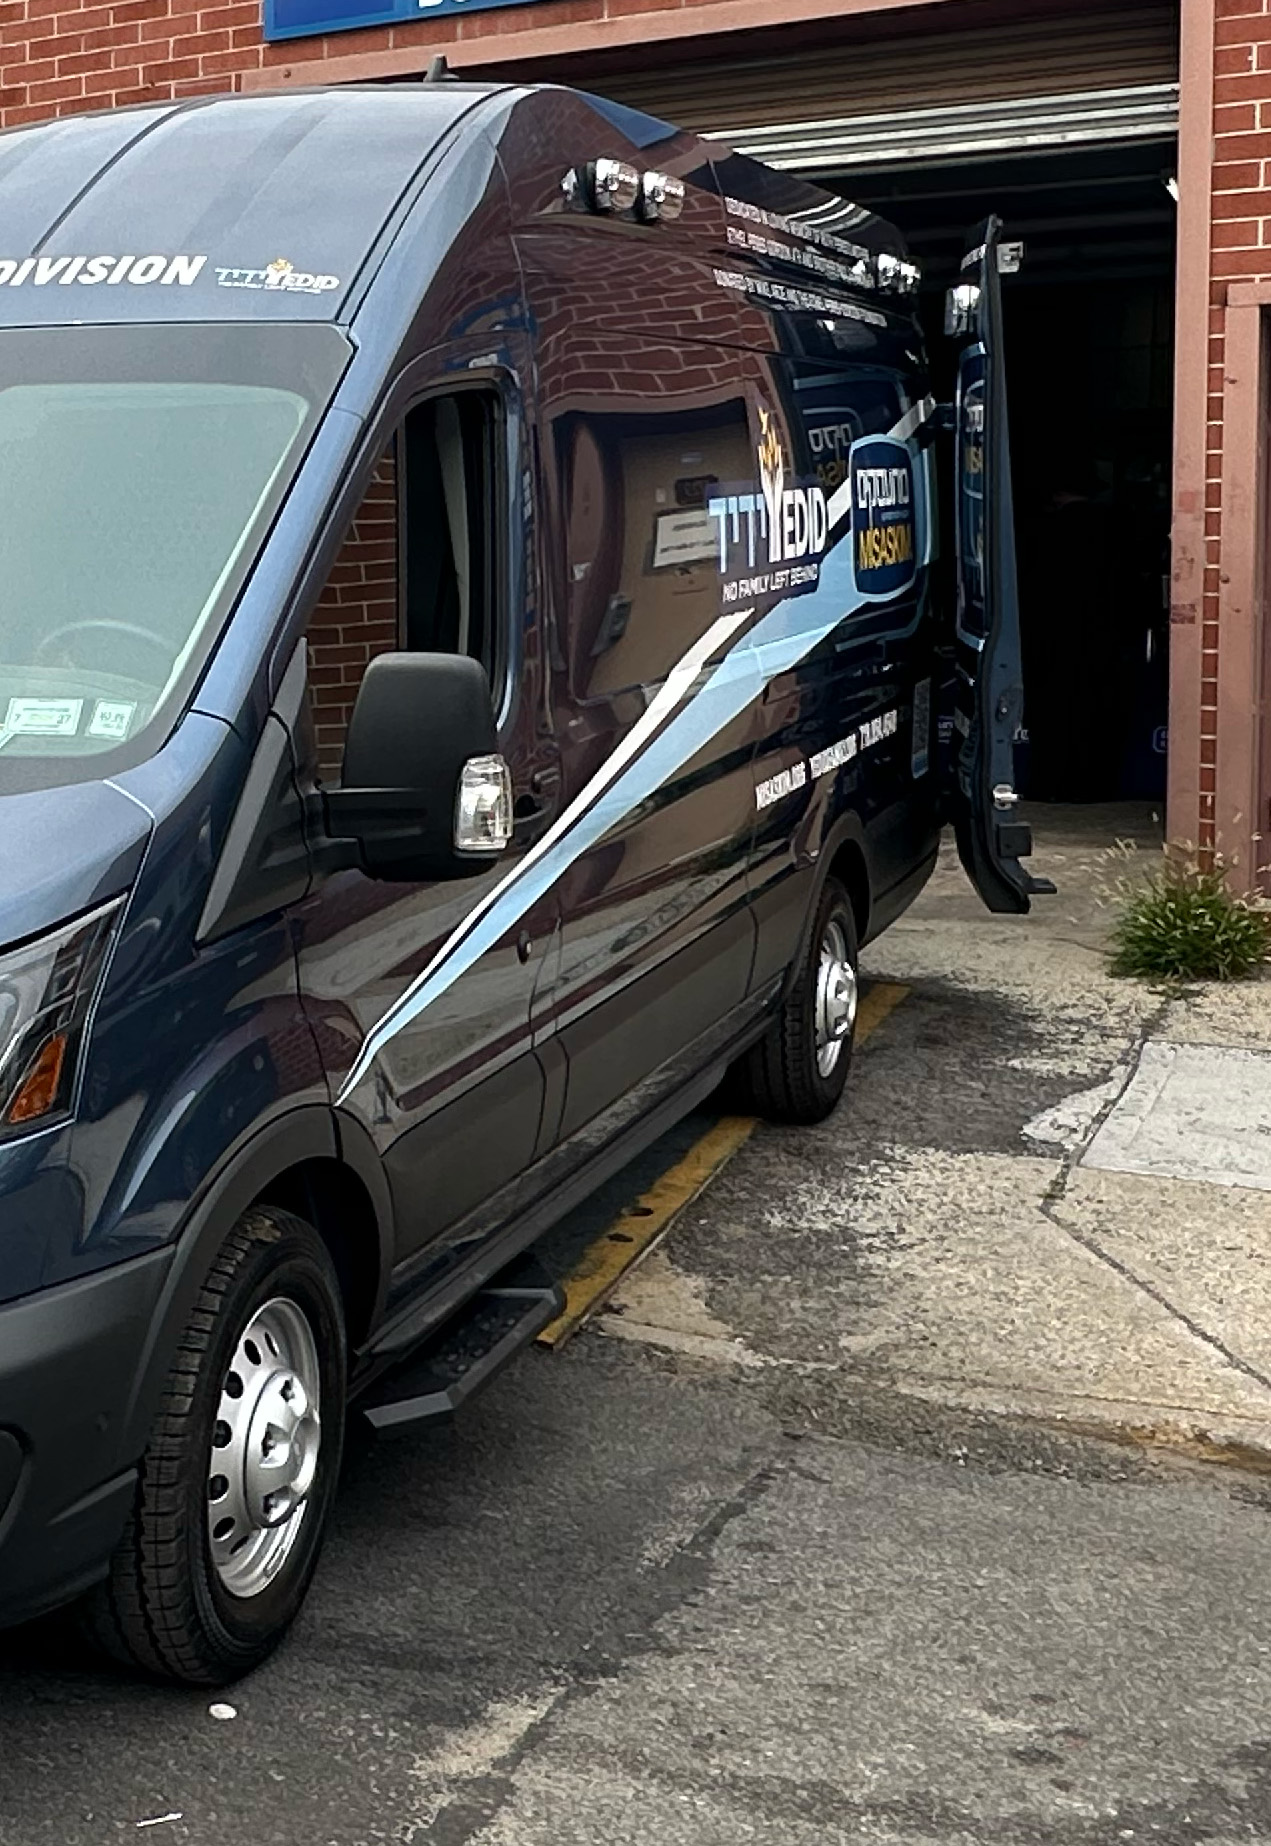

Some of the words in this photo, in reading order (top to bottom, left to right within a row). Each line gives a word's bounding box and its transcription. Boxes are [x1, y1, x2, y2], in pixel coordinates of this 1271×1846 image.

[265, 263, 340, 290] YEDID
[759, 446, 827, 562] YEDID
[860, 523, 913, 571] MISASKIM
[739, 575, 769, 599] FAMILY
[770, 569, 789, 591] LEFT
